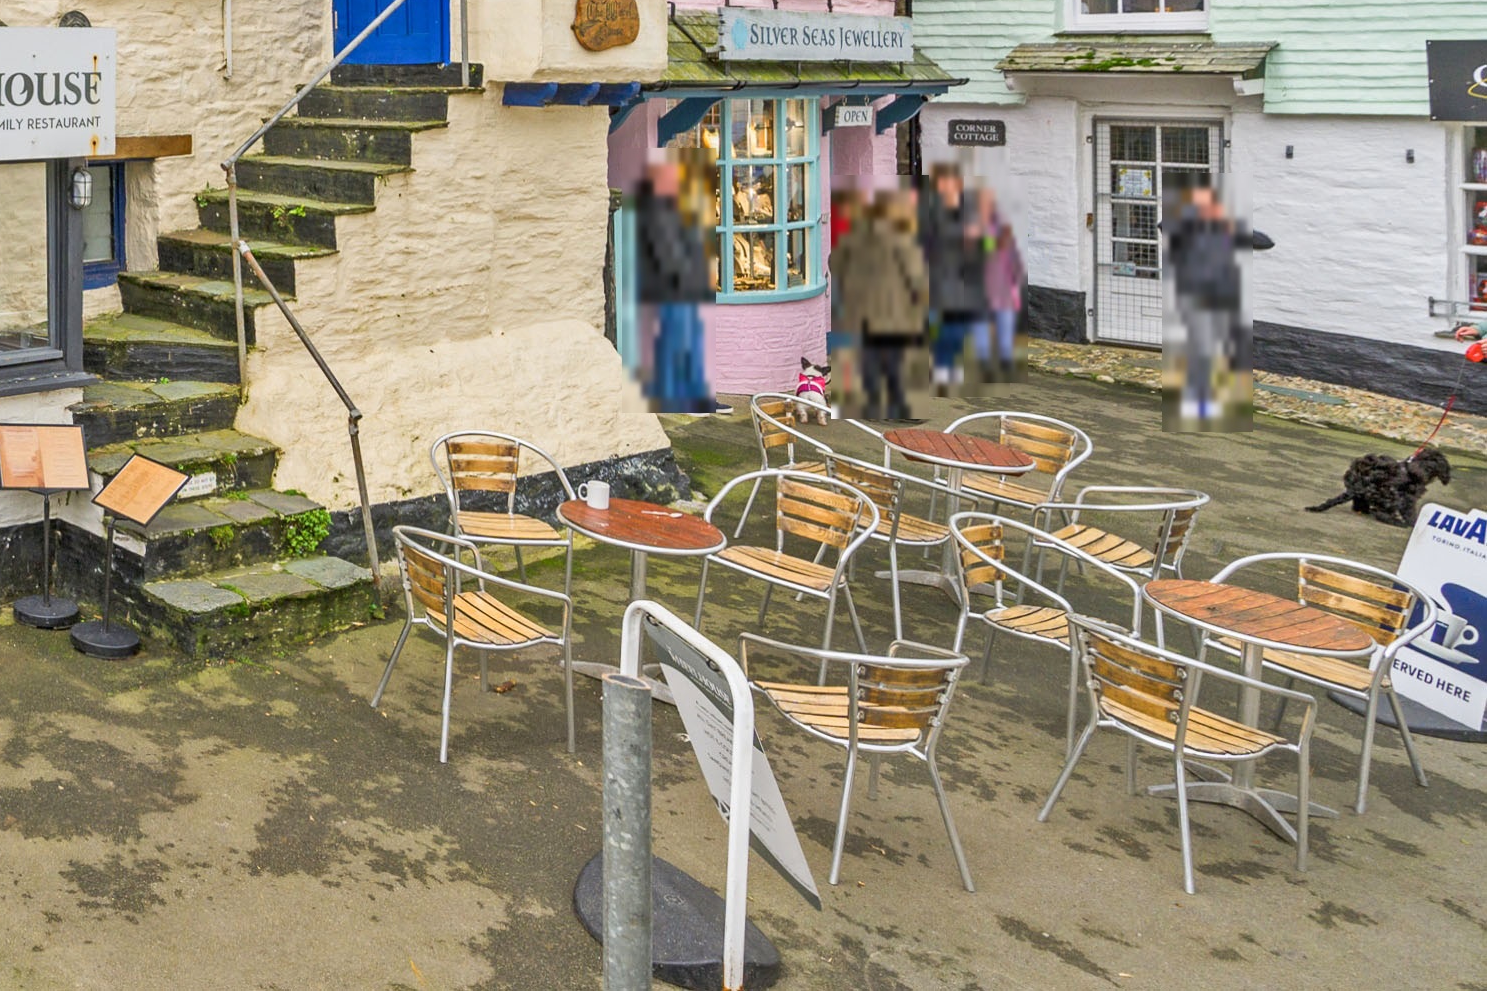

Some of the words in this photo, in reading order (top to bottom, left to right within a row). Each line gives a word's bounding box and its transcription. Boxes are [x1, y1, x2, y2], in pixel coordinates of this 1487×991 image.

[750, 23, 798, 46] SILVER
[802, 25, 836, 47] SEAS
[839, 26, 905, 49] JEWELLERY
[26, 115, 101, 130] RESTAURANT
[843, 110, 868, 123] OPEN
[955, 124, 997, 133] CORNER
[954, 132, 999, 141] COTTAGE
[1427, 510, 1487, 545] LAVA
[1393, 658, 1433, 685] ERVED
[1436, 677, 1471, 703] HERE
